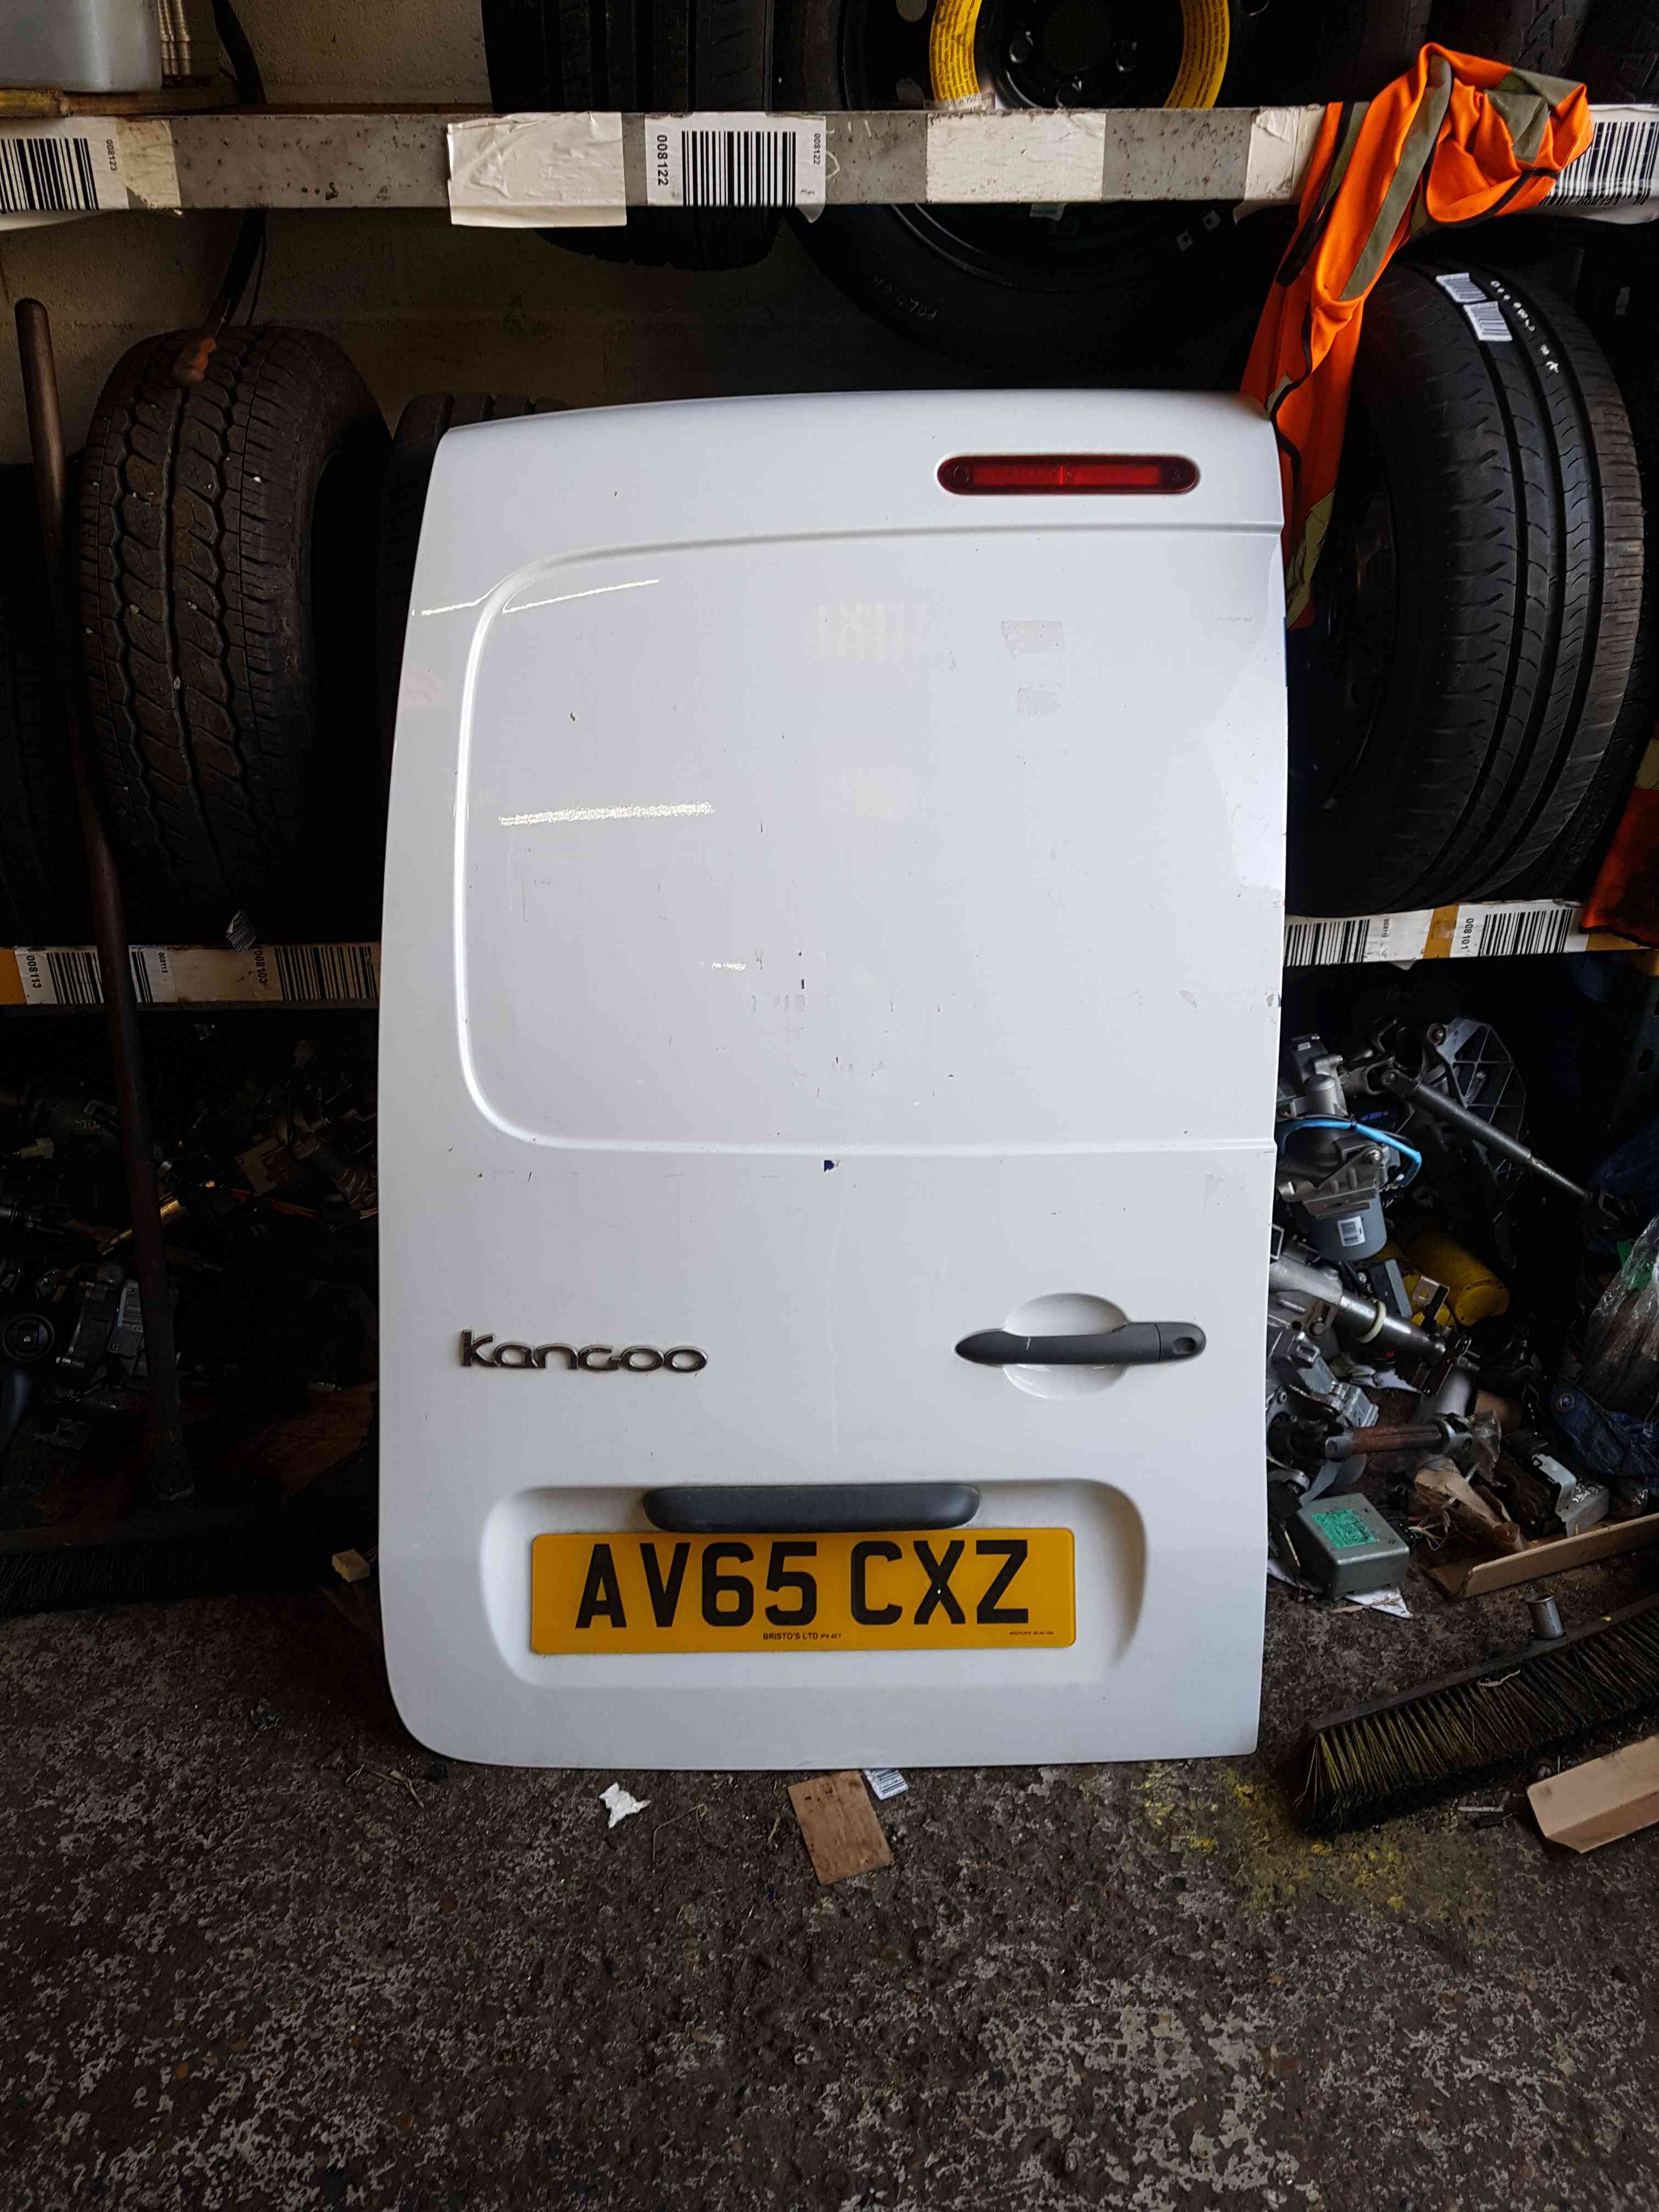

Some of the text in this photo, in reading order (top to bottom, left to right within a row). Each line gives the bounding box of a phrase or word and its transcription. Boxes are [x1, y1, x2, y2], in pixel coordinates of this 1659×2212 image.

[657, 135, 669, 186] 008122
[1460, 918, 1475, 950] 008101
[26, 955, 42, 989] 008113
[253, 950, 268, 984] 008103
[575, 1539, 1029, 1628] AV65 CXZ
[763, 1632, 800, 1640] BRISTO'S
